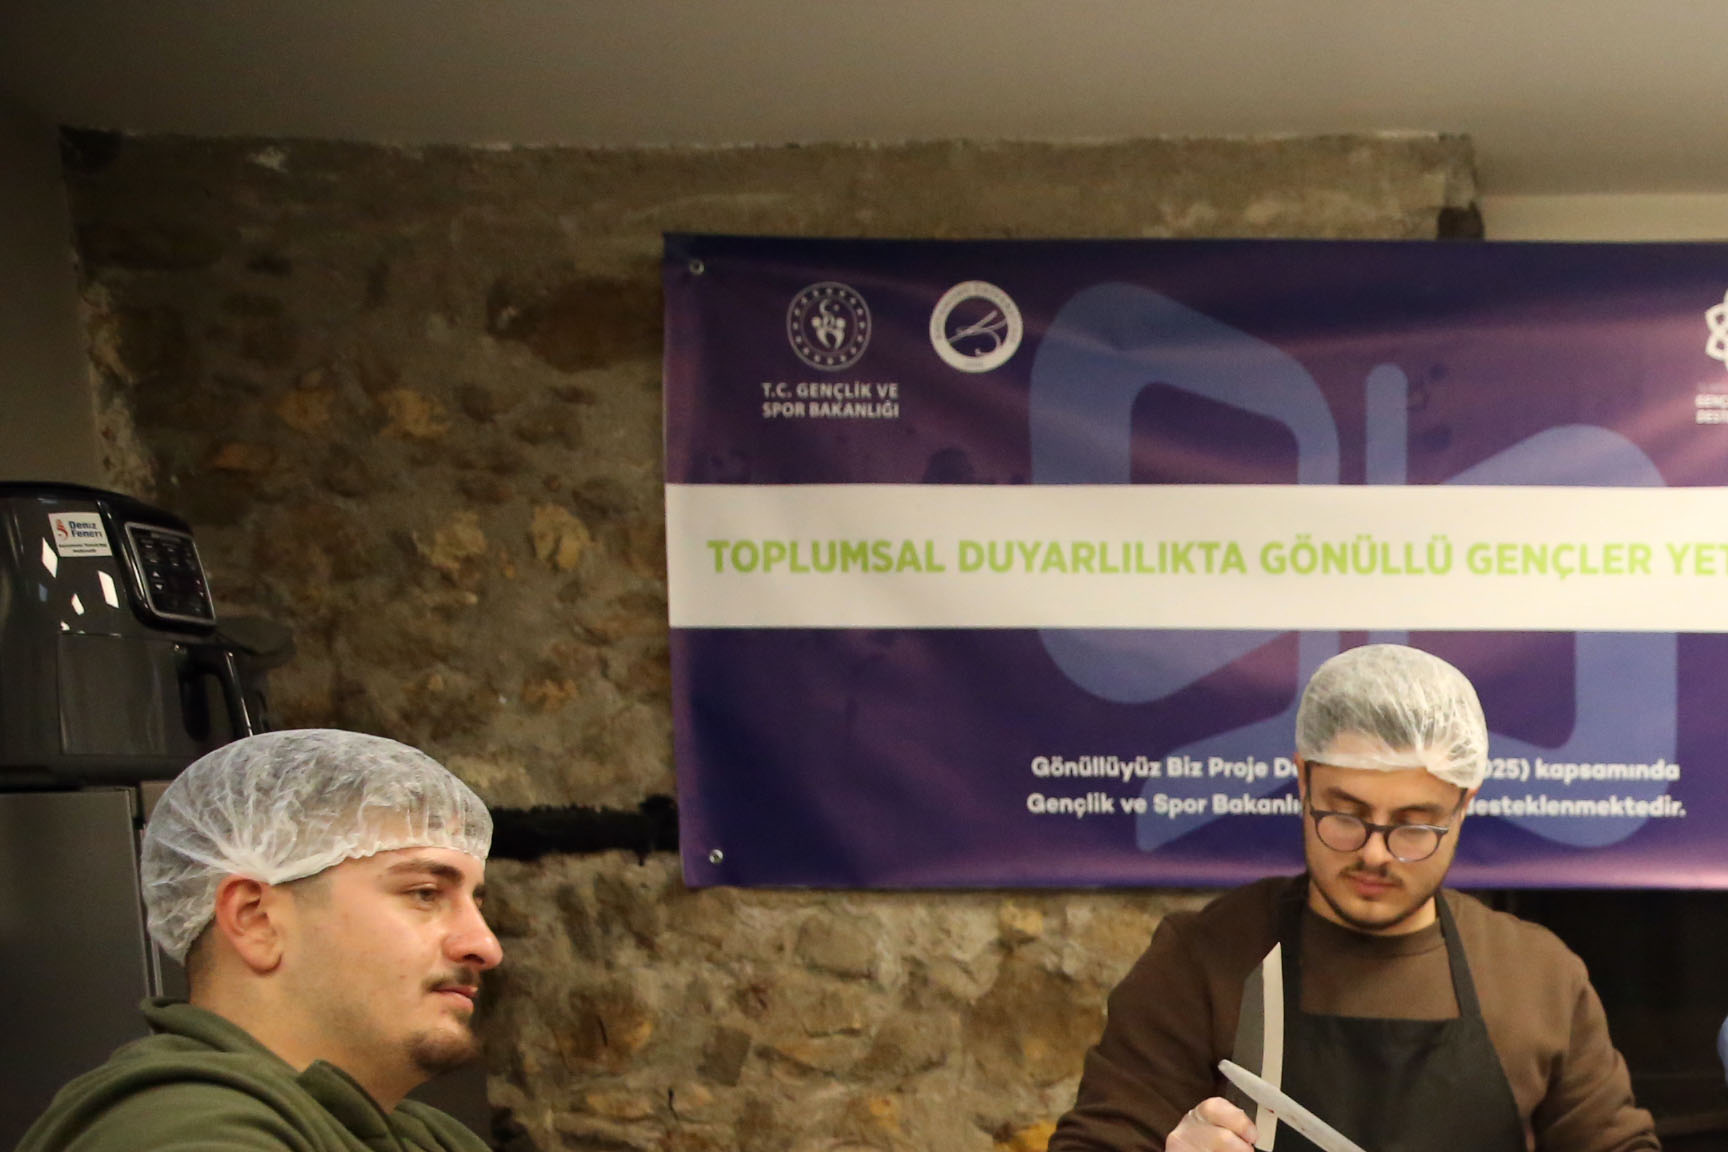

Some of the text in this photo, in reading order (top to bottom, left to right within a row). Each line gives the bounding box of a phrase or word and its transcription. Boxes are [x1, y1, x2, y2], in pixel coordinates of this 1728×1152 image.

[762, 383, 792, 398] T.C.
[876, 383, 898, 398] VE
[762, 400, 899, 418] SPOR BAKANLIĞI
[707, 539, 945, 574] TOPLUMSAL
[957, 539, 1247, 574] DUYARLILIKTA
[1259, 534, 1454, 576] GÖNÜLLÜ
[1466, 543, 1652, 580] GENÇLER
[1031, 756, 1161, 782] Gönüllüyüz
[1166, 757, 1203, 777] Biz
[1208, 757, 1268, 783] Proje
[1535, 758, 1680, 786] kapsamında
[1026, 792, 1115, 819] Gençlik
[1120, 799, 1148, 814] ve
[1154, 793, 1206, 819] Spor
